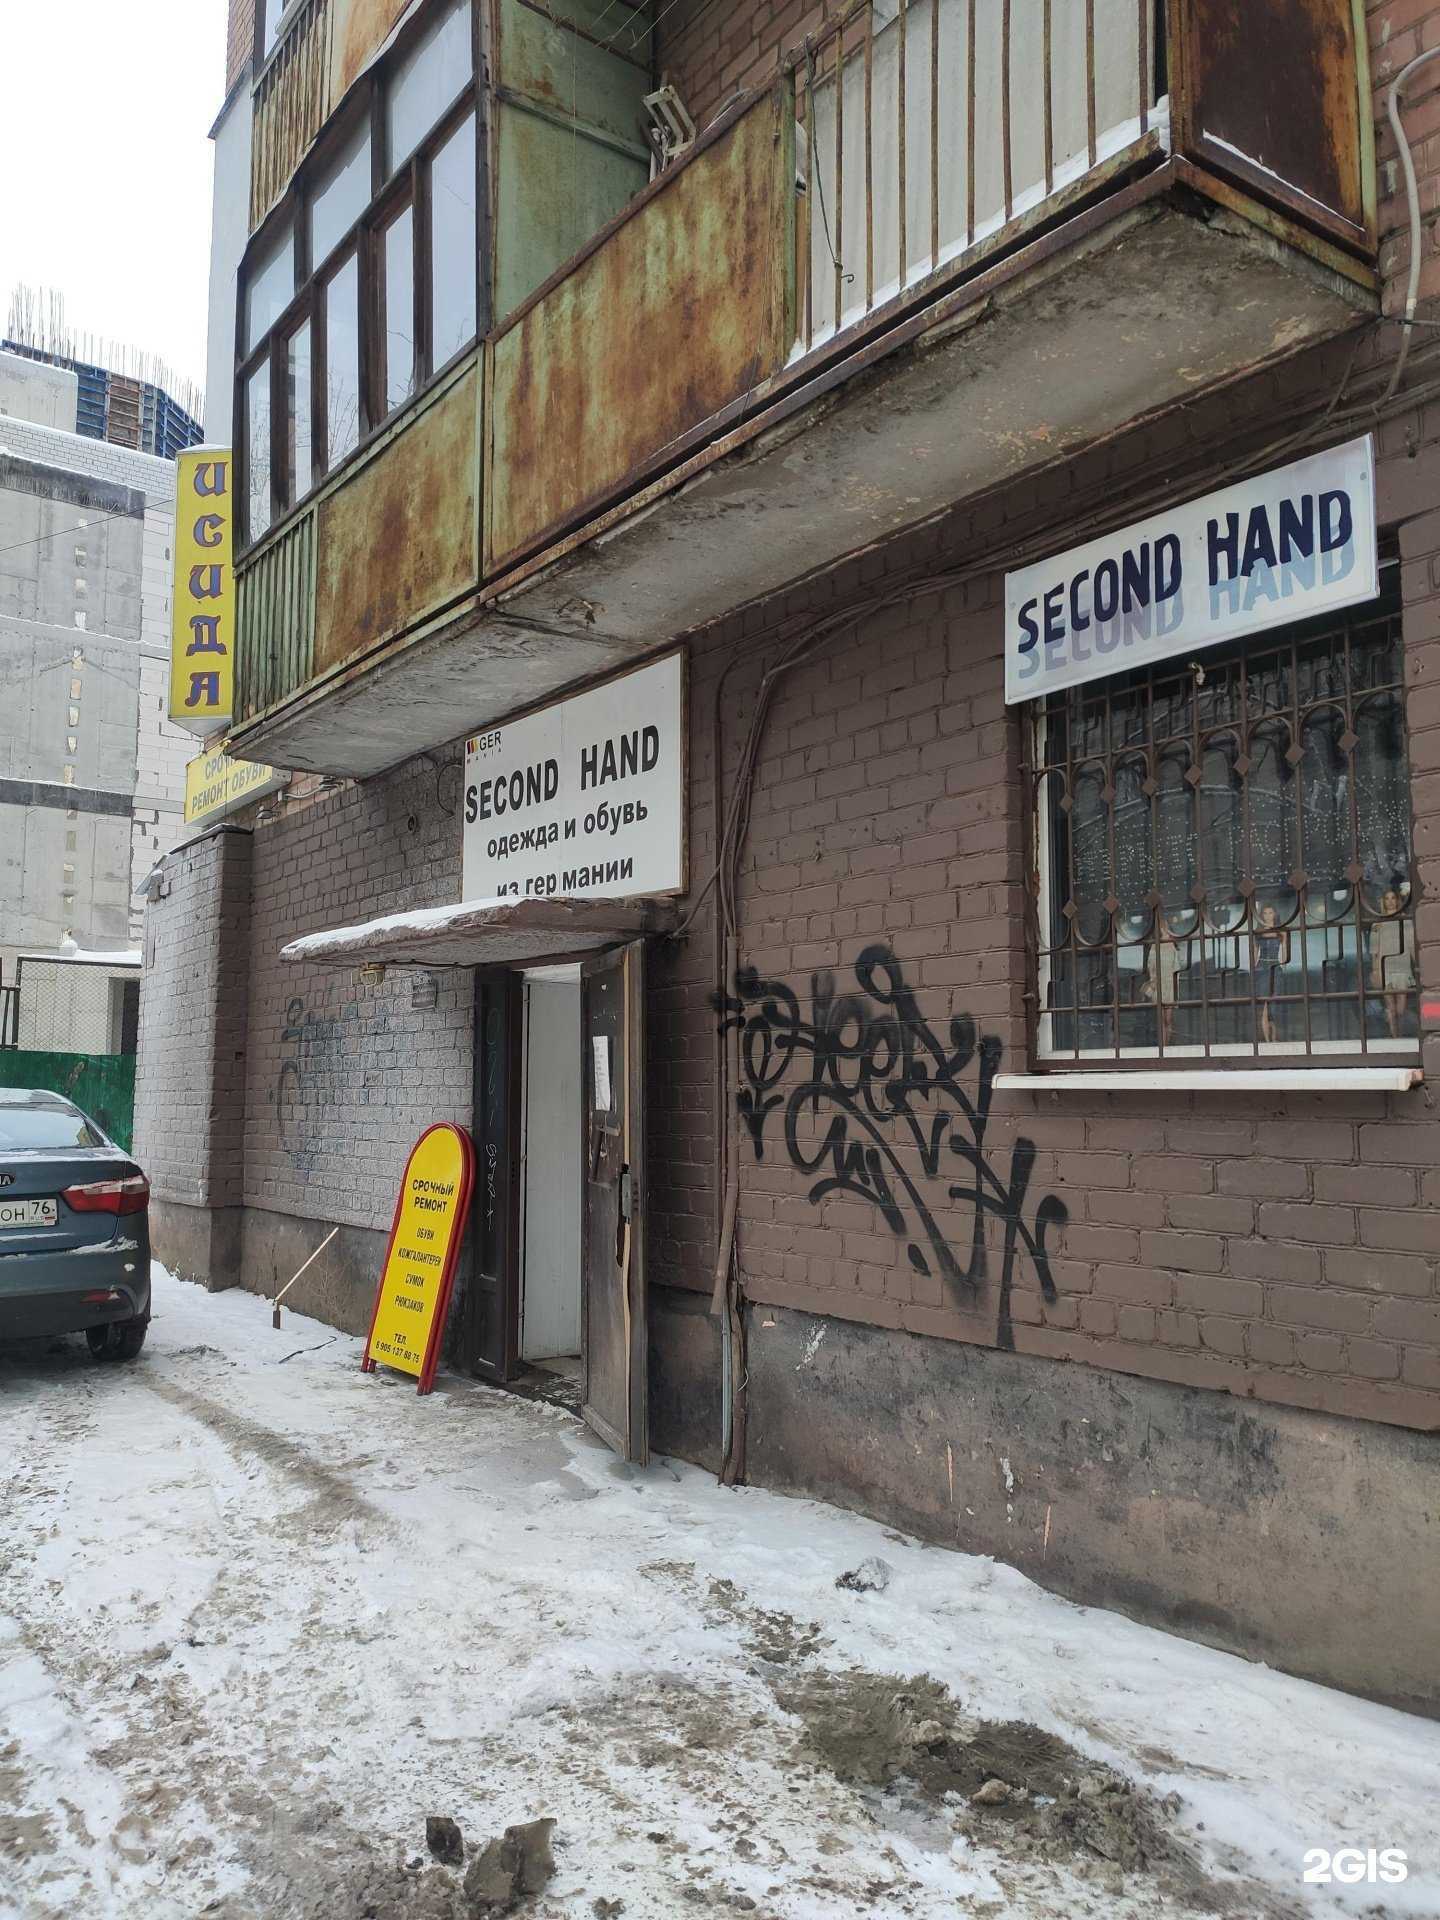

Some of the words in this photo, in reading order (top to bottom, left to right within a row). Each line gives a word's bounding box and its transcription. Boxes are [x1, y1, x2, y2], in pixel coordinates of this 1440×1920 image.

[185, 461, 229, 707] ИСИДА
[1018, 533, 1183, 655] SECOND
[1207, 489, 1354, 586] HAND
[480, 731, 502, 751] GER
[192, 777, 230, 814] РЕМОНТ
[232, 763, 266, 792] ОБУВИ
[465, 757, 559, 824] SECOND
[580, 724, 660, 791] HAND
[487, 821, 559, 860] одежда
[564, 816, 576, 840] и
[583, 799, 648, 836] обувь
[412, 1179, 455, 1197] СРОЧНЫЙ
[414, 1196, 448, 1213] РЕМОНТ
[31, 1200, 51, 1215] 76
[416, 1226, 435, 1241] ОБУВИ
